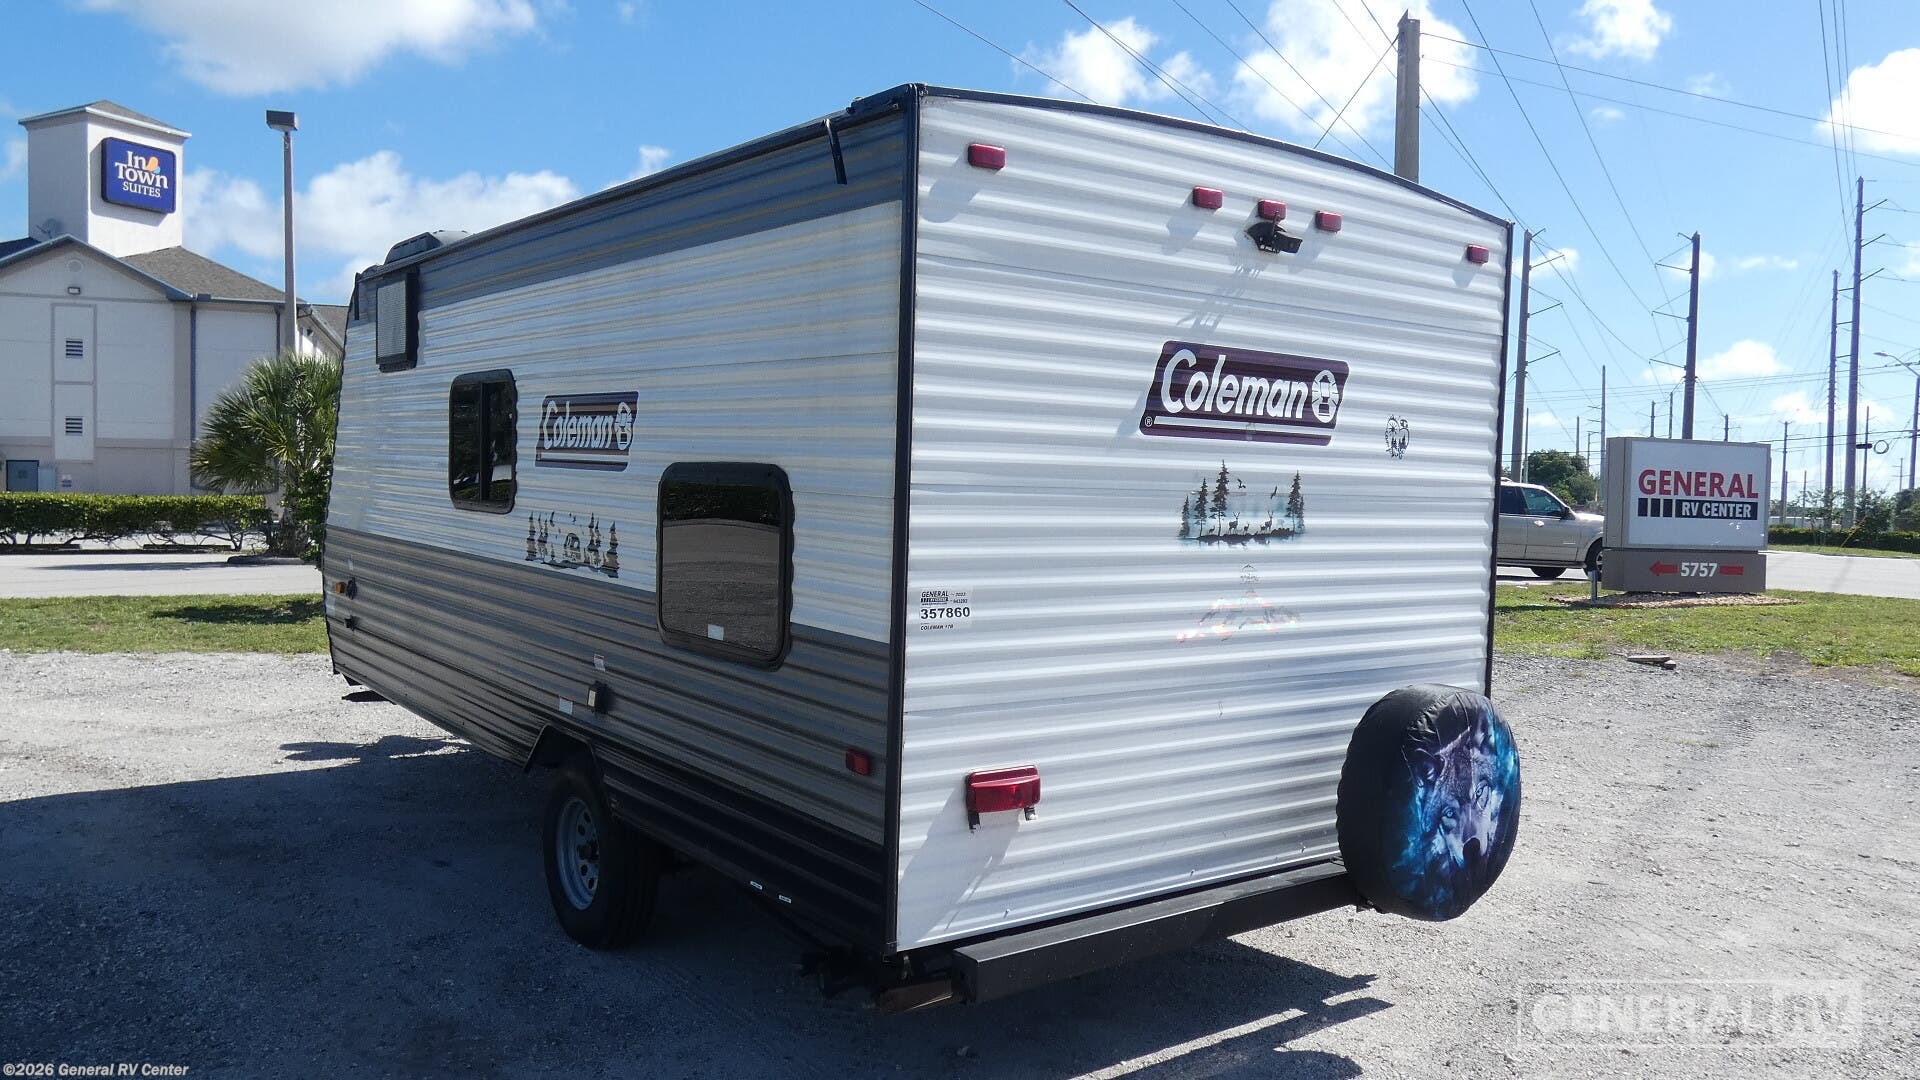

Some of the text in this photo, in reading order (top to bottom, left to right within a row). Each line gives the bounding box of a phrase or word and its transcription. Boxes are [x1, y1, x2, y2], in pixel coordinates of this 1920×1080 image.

[126, 151, 147, 170] In
[115, 162, 168, 189] Town
[122, 181, 161, 198] SUITES
[1160, 348, 1308, 419] Coleman
[543, 400, 613, 450] Coleman
[1638, 469, 1759, 499] GENERAL
[1682, 501, 1752, 518] RV CENTER
[1680, 562, 1718, 578] 5757
[921, 590, 948, 598] GENERAL
[920, 606, 970, 620] 357860
